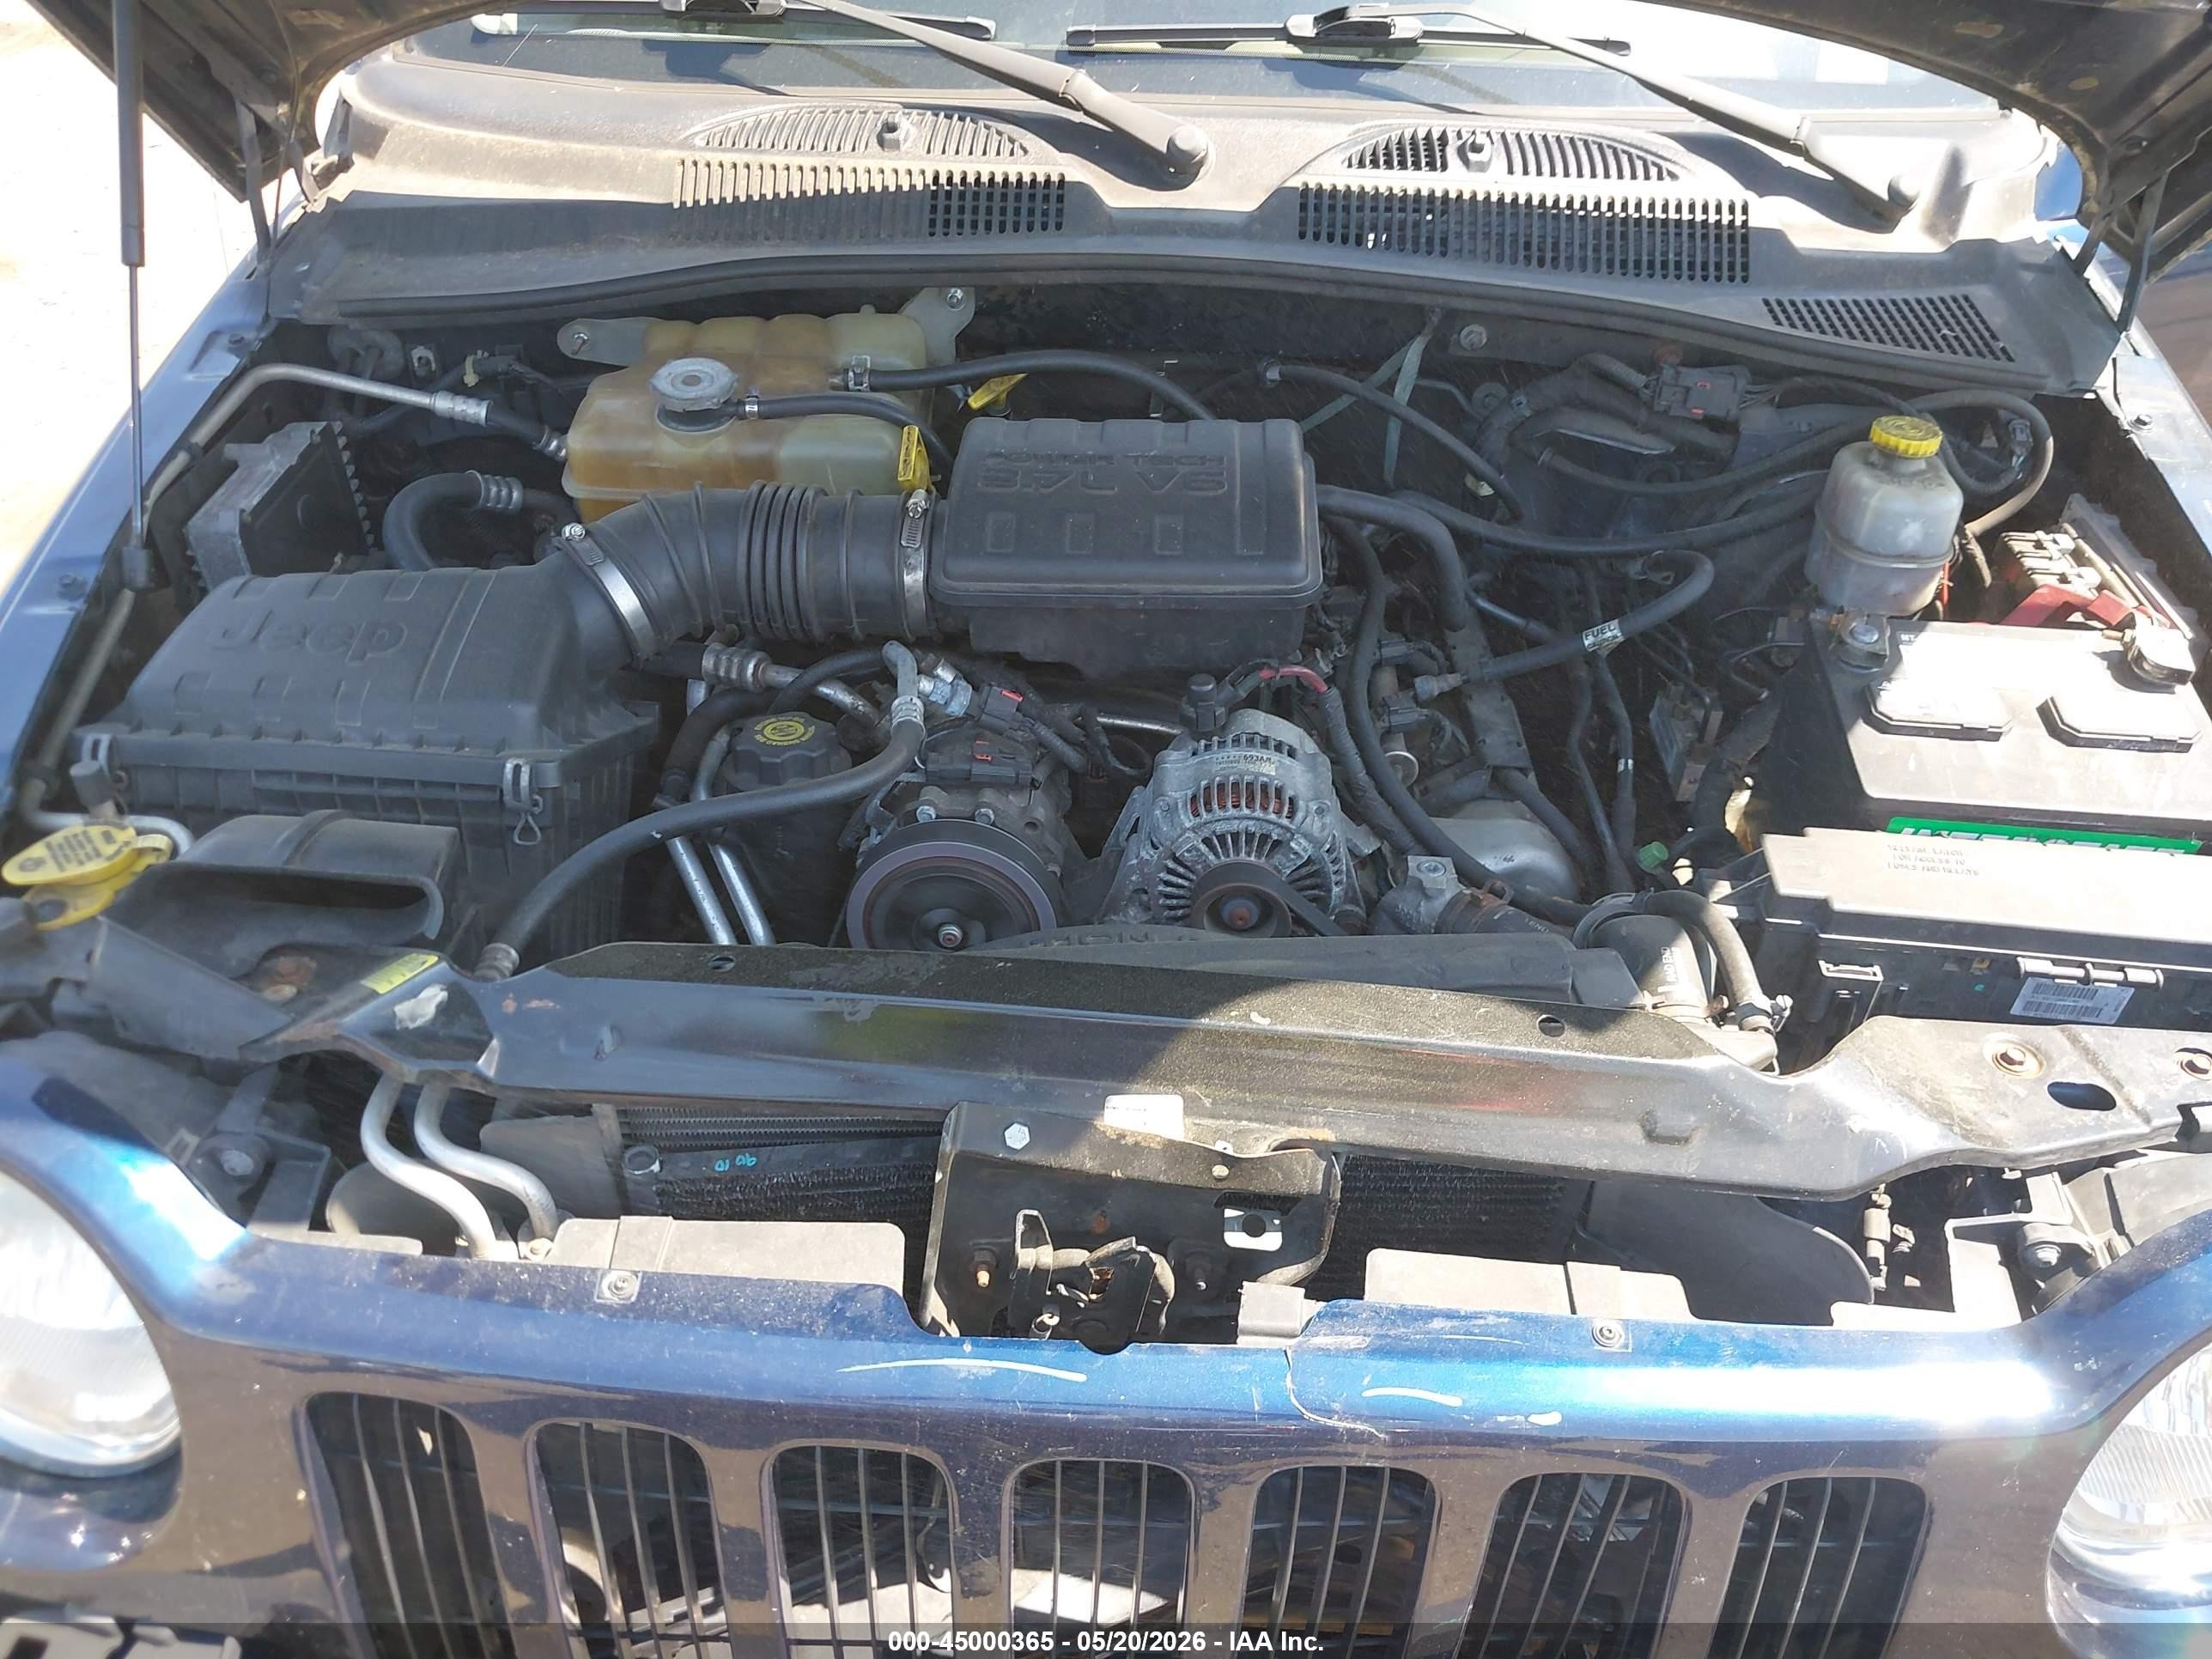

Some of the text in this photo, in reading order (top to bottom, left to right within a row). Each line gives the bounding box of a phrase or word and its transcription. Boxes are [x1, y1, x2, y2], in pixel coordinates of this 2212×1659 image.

[1133, 466, 1229, 495] V6
[206, 610, 409, 666] Jeep
[1584, 623, 1617, 641] FUEL
